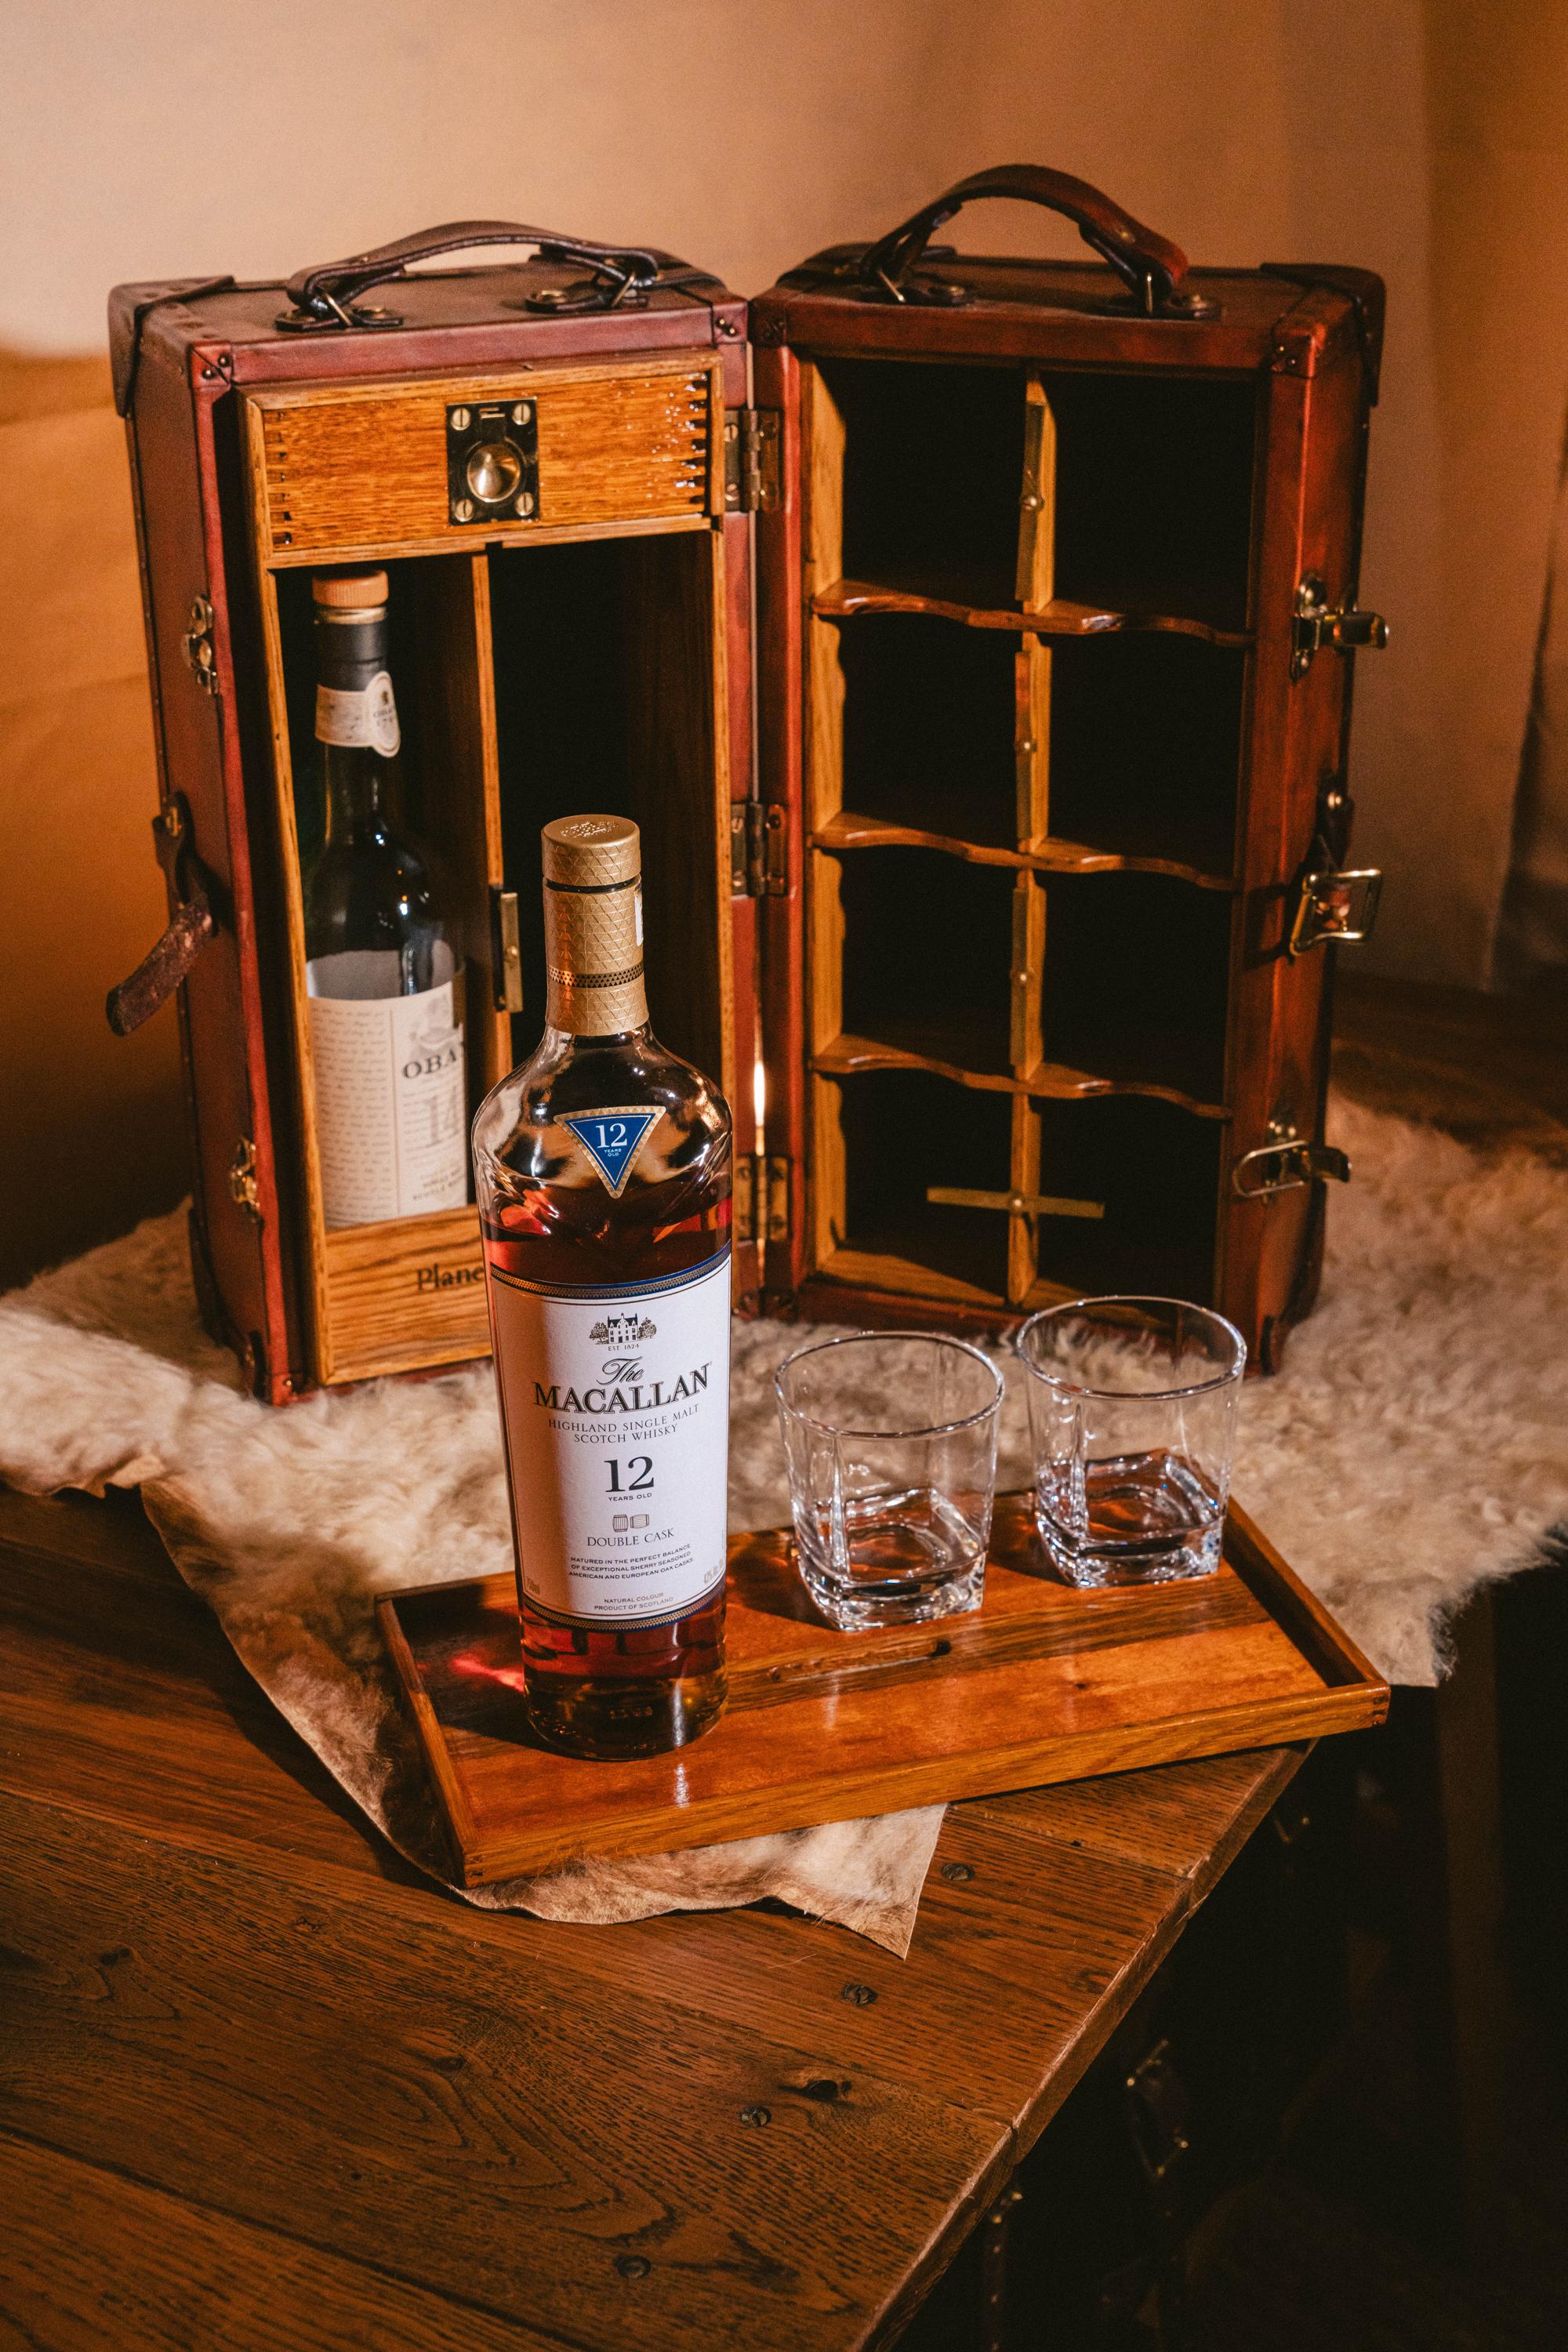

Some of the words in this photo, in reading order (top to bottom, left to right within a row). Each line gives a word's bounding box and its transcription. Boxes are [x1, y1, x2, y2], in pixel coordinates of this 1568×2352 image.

[402, 1042, 464, 1079] OBA
[596, 1123, 628, 1149] 12
[596, 1356, 645, 1386] The
[532, 1362, 710, 1415] MACALLAN
[548, 1418, 617, 1433] HIGHLAND
[622, 1415, 667, 1432] SINGLE
[672, 1403, 699, 1421] MALT
[574, 1434, 626, 1444] SCOTCH
[631, 1423, 678, 1441] WHISKY
[604, 1456, 655, 1493] 12
[586, 1535, 640, 1548] DOUBLE
[644, 1527, 675, 1544] CASK
[570, 1556, 604, 1565] MATURED
[630, 1553, 662, 1563] PERFECT
[662, 1543, 691, 1557] BALANCE
[630, 1562, 658, 1571] SHERRY
[658, 1551, 691, 1566] SEASONED
[568, 1571, 604, 1580] AMERICAN
[621, 1569, 659, 1579] EUROPEAN
[674, 1557, 694, 1569] CASKS
[636, 1592, 664, 1602] COLOUR
[639, 1596, 674, 1609] SCOTLAND
